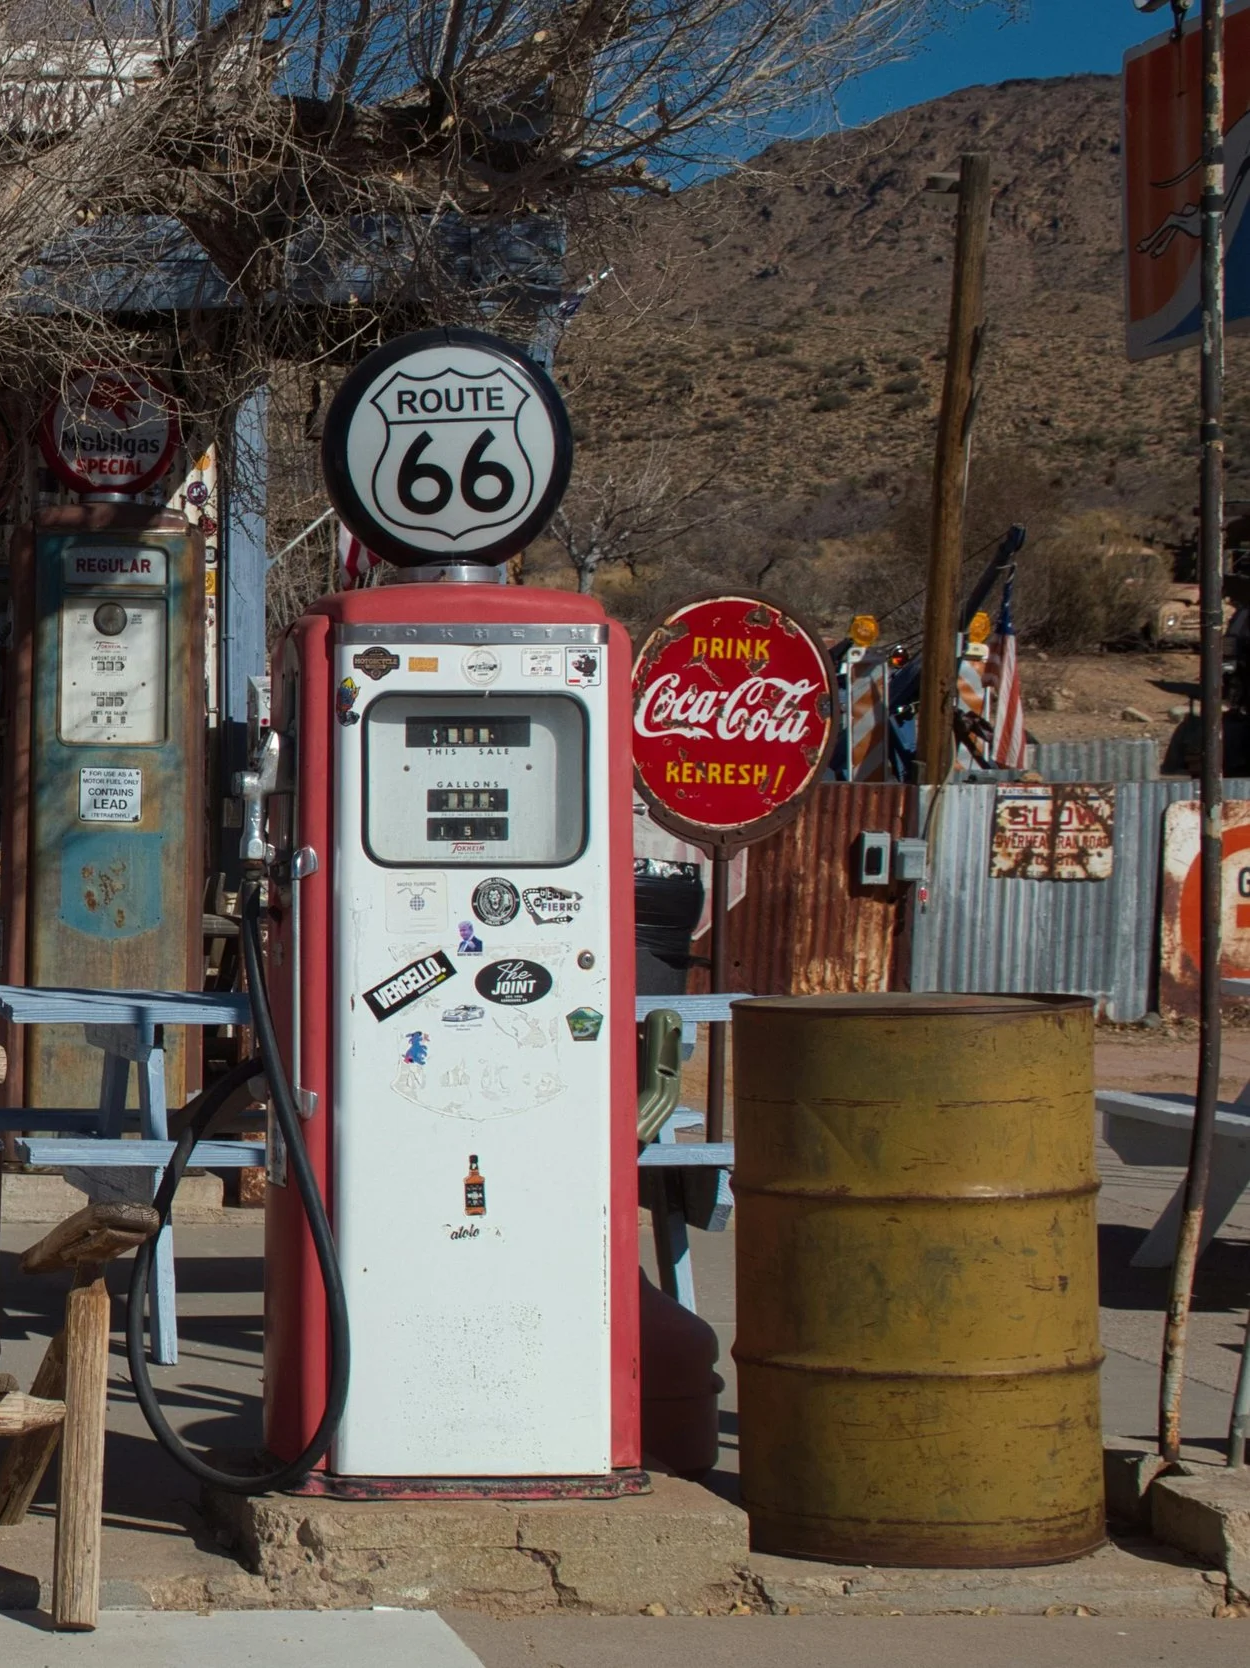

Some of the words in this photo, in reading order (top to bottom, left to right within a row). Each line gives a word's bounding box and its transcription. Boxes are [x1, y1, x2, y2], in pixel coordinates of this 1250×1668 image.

[397, 387, 505, 415] ROUTE
[63, 431, 160, 459] Mobilgas
[75, 459, 144, 476] SPECIAL
[397, 428, 515, 515] 66
[76, 558, 151, 574] REGULAR
[693, 637, 771, 660] DRINK
[634, 673, 820, 743] Coca-Cola
[88, 788, 134, 797] CONTAINS
[93, 799, 128, 810] LEAD
[451, 842, 486, 854] TOKHEIM
[995, 834, 1049, 848] OVERHEA
[541, 902, 580, 911] FIERRO
[497, 961, 532, 981] The
[491, 980, 537, 995] JOINT
